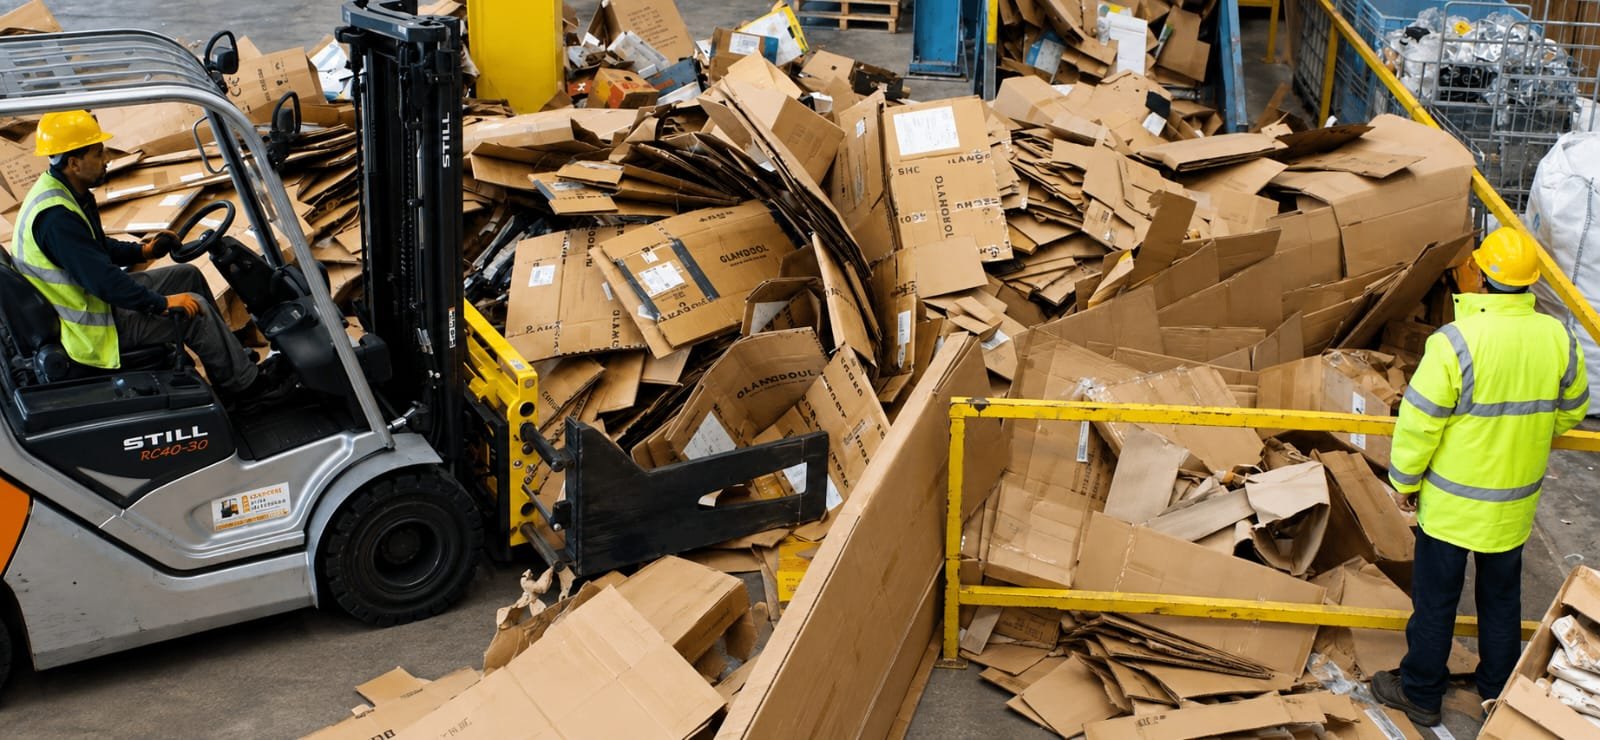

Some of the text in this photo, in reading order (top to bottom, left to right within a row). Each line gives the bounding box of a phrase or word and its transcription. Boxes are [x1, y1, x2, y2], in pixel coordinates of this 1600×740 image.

[442, 111, 450, 168] STILL
[123, 425, 208, 451] STILL
[141, 439, 209, 460] RC40-30
